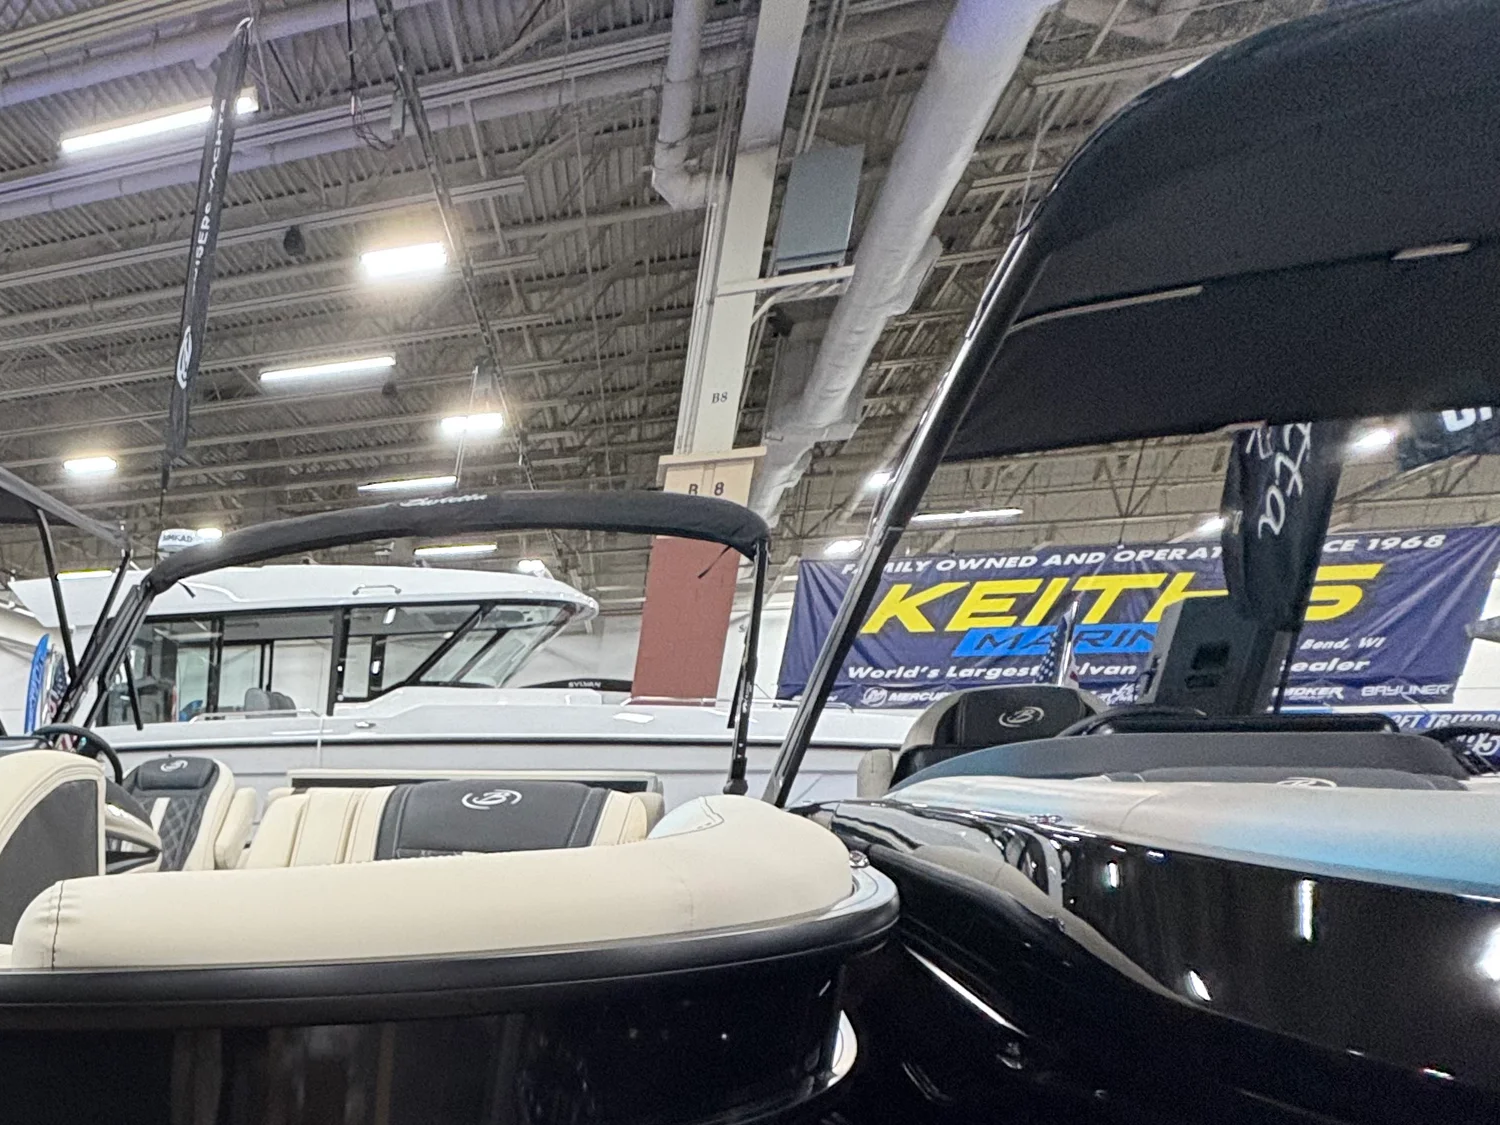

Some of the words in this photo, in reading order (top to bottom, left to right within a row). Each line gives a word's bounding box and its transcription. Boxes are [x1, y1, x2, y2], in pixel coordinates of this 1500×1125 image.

[711, 391, 729, 405] B8
[713, 481, 725, 496] 8
[840, 559, 932, 575] FMILY
[936, 555, 1038, 572] OWNED
[1041, 552, 1106, 567] AND
[1113, 546, 1223, 562] OPERAT
[1366, 534, 1447, 551] 1968
[860, 563, 1386, 633] KEITHS
[974, 629, 1156, 651] MARIN
[1299, 637, 1350, 651] Bend,
[1358, 636, 1387, 649] WI
[847, 665, 940, 680] World's
[949, 664, 1040, 681] Largest
[1075, 662, 1138, 676] lvan
[1280, 657, 1370, 673] ealer
[887, 691, 951, 702] MERCUR
[1361, 683, 1453, 697] BAYLINER
